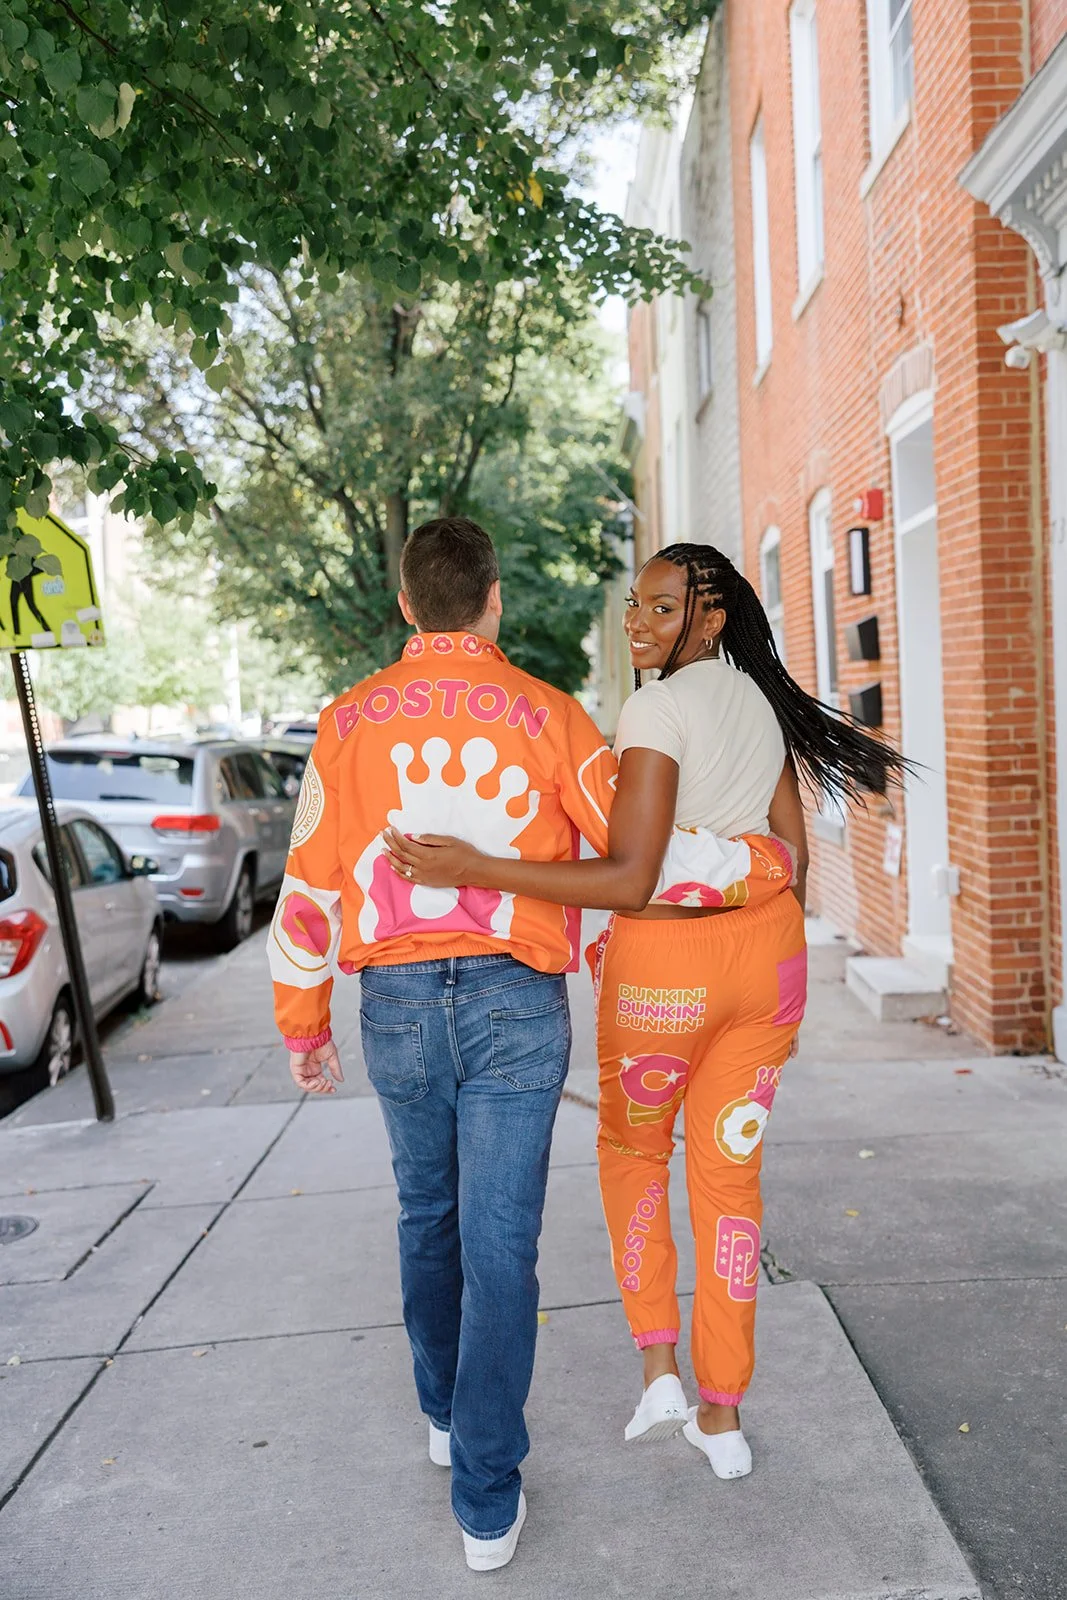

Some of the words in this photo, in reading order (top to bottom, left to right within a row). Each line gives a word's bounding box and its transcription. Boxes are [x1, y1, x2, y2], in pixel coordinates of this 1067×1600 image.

[334, 680, 549, 740] BOSTON
[303, 793, 319, 828] BOSTON
[618, 983, 706, 1004] DUNKIN'
[618, 998, 705, 1019] DUNKIN'
[616, 1013, 704, 1033] DUNKIN'
[620, 1179, 666, 1292] BOSTON
